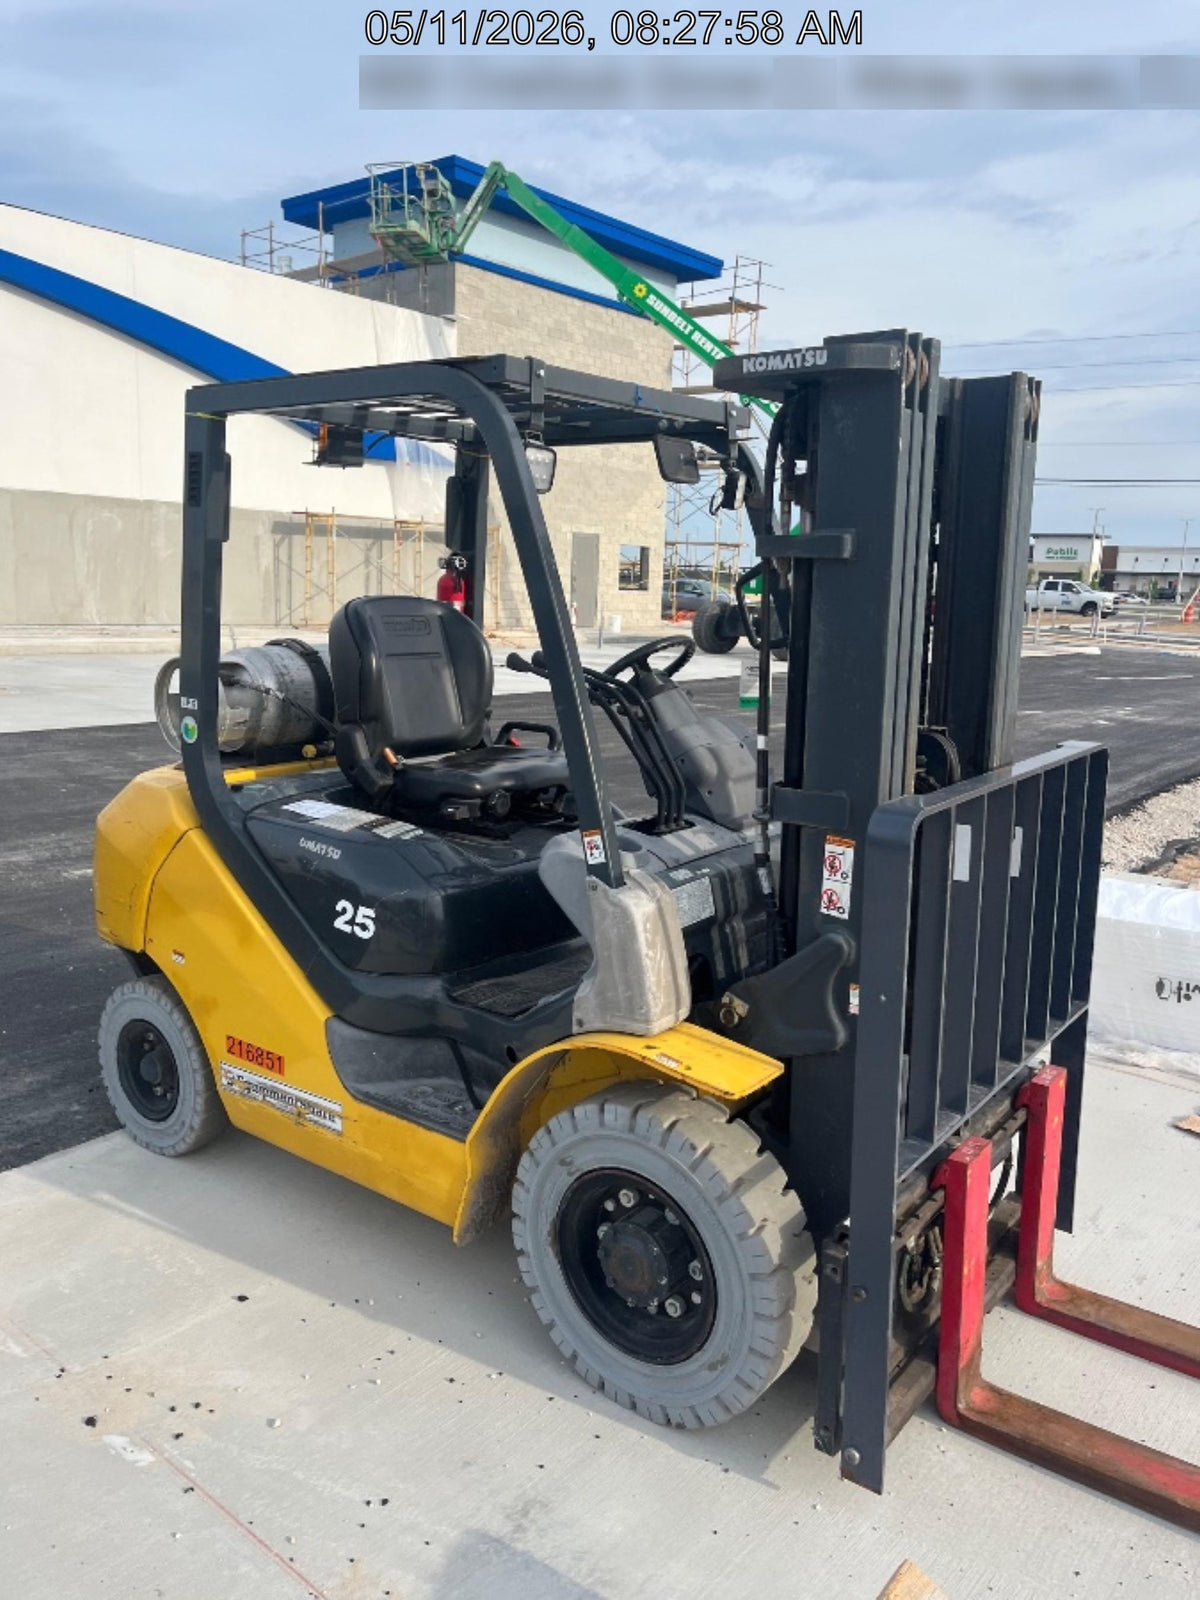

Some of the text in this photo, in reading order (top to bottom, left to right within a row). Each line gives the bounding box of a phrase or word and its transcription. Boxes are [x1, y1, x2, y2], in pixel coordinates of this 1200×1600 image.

[646, 294, 694, 336] SUNBELT
[742, 349, 828, 374] KOMATSU
[333, 899, 376, 939] 25
[226, 1036, 283, 1076] 216851
